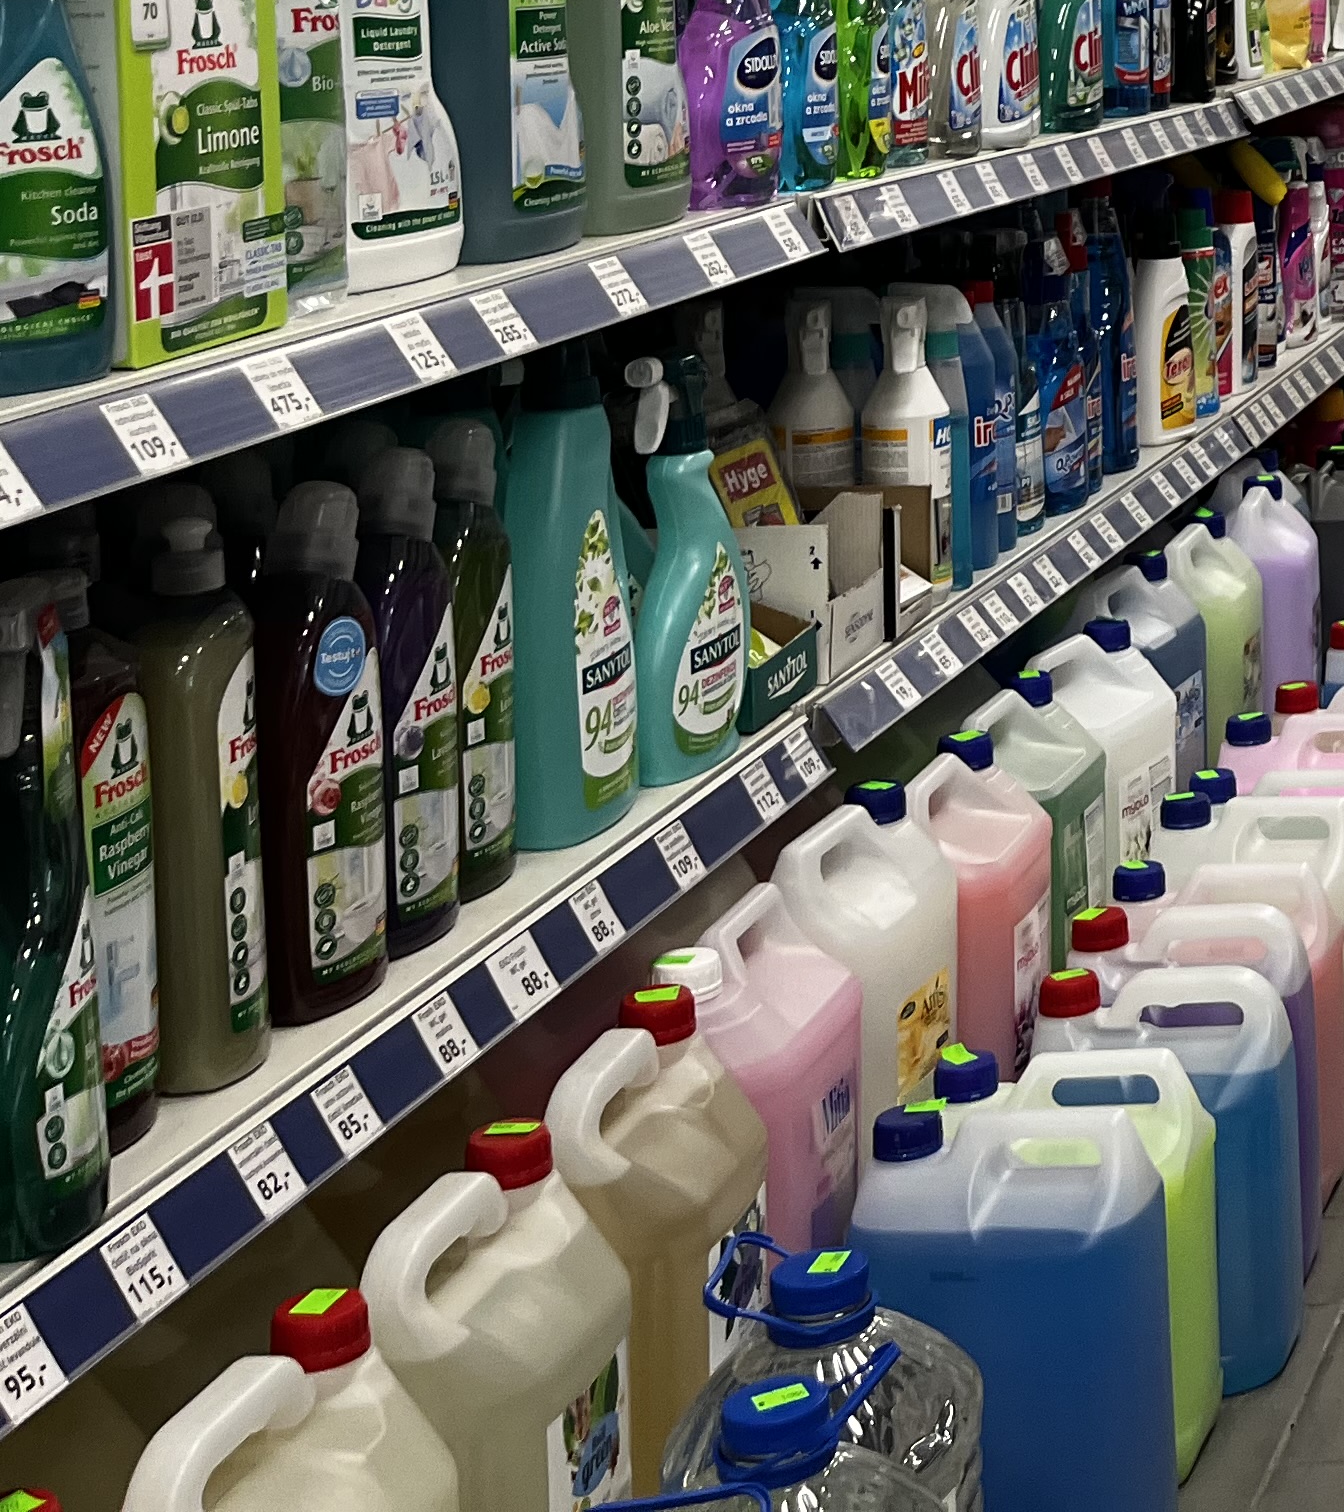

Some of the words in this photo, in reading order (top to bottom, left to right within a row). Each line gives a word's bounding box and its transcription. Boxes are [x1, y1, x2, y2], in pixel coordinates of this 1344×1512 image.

[142, 2, 158, 21] 70
[361, 27, 388, 39] Liquid
[640, 20, 660, 35] Aloe
[519, 39, 552, 54] Active
[176, 44, 238, 76] Frosch
[196, 99, 223, 117] Classic
[728, 101, 755, 114] okna
[807, 91, 827, 103] okna
[726, 116, 734, 127] a
[735, 111, 769, 126] zrcadla
[197, 123, 260, 155] Limone
[51, 202, 99, 226] Soda
[611, 288, 641, 307] 272,-
[495, 324, 529, 346] 265,-
[410, 349, 448, 372] 125,-
[270, 392, 312, 419] 475,-
[130, 435, 179, 467] 109,-
[725, 460, 769, 493] Hyge
[693, 630, 741, 668] SANYTOL
[586, 649, 632, 690] SANYTOL
[767, 649, 808, 695] SANYTOL
[677, 678, 700, 717] 94
[88, 712, 114, 755] NEW
[584, 698, 613, 752] 94
[107, 846, 150, 881] Vinegar
[672, 854, 699, 879] 109,-
[591, 920, 616, 943] 88,-
[521, 971, 550, 997] 88,-
[438, 1038, 469, 1064] 88,-
[338, 1113, 370, 1141] 85,-
[257, 1170, 291, 1201] 82,-
[127, 1264, 176, 1304] 115,-
[4, 1364, 48, 1401] 95,-
